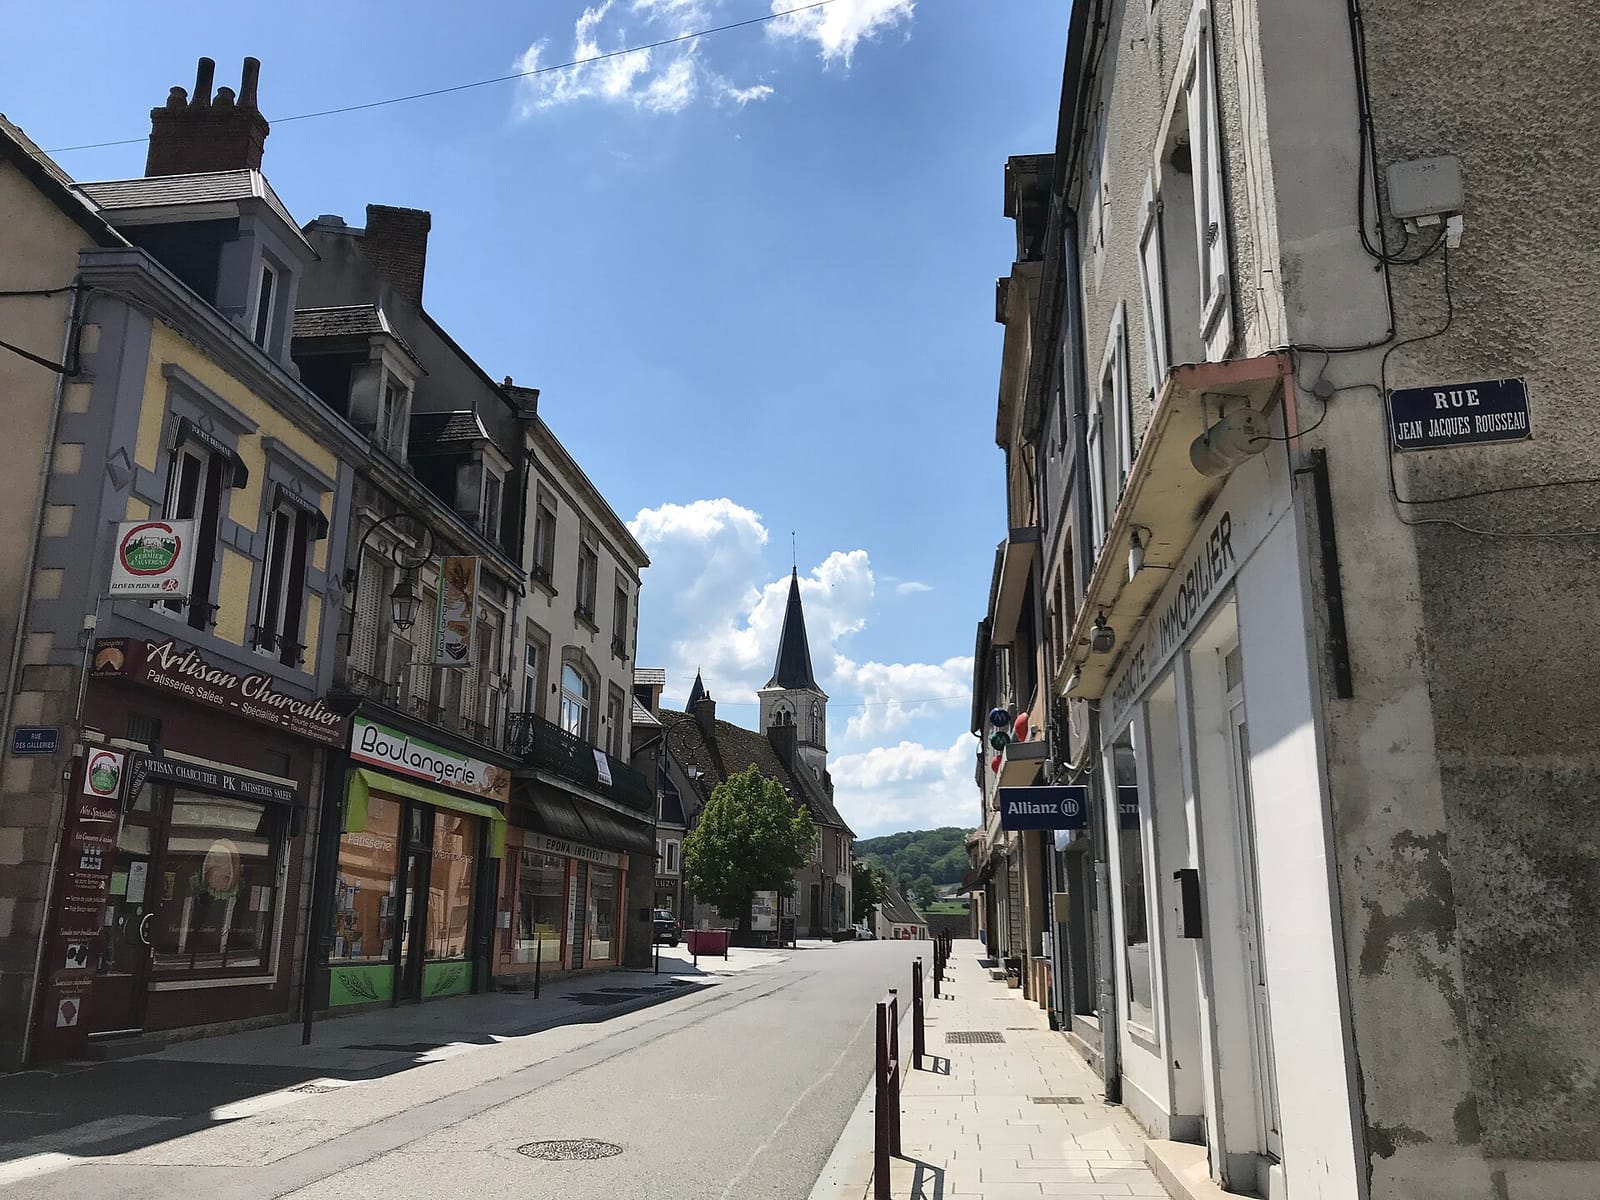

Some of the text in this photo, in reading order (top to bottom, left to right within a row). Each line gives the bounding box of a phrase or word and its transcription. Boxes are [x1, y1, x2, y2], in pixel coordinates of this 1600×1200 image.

[1433, 389, 1480, 409] RUE
[1398, 411, 1526, 441] JEAN JACQUES ROUSSEAU
[1158, 511, 1234, 657] IMMOBILIER
[146, 641, 341, 726] Artisan Charcutier
[360, 725, 475, 783] Boulangerie
[175, 766, 217, 785] CHARCUTIER
[223, 775, 236, 791] PK
[240, 780, 273, 797] PATISSERIES
[1007, 801, 1058, 815] Allianz
[546, 838, 604, 860] EPONA INSTITUT
[655, 880, 675, 888] LUZY
